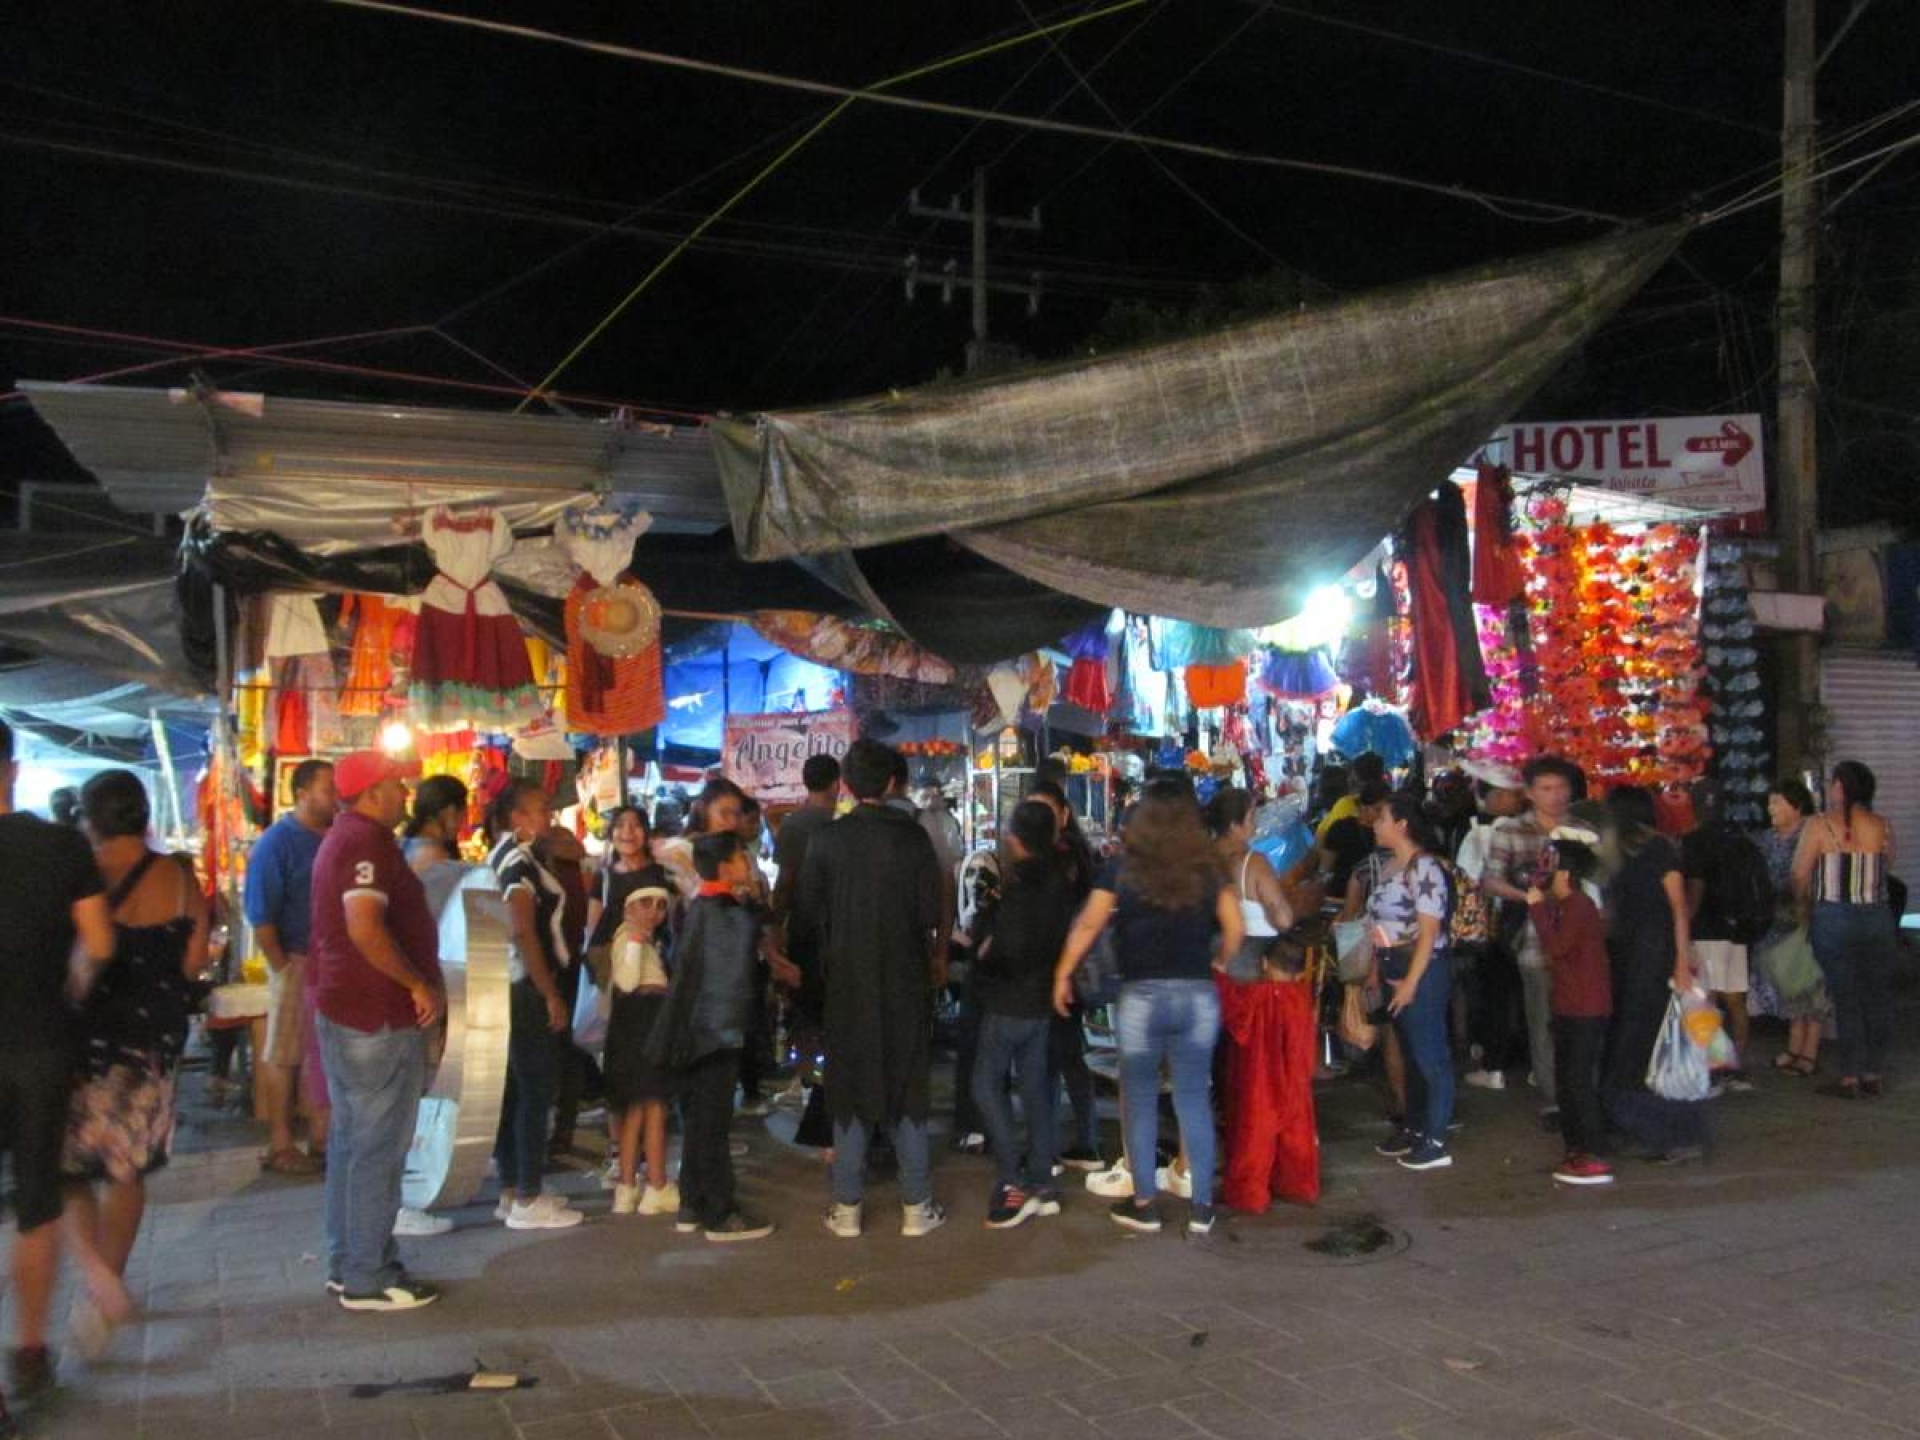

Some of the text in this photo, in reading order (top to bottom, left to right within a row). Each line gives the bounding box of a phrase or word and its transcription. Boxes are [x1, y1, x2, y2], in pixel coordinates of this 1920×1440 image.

[1514, 423, 1671, 472] HOTEL
[735, 731, 847, 771] Angelito
[355, 861, 374, 885] 3
